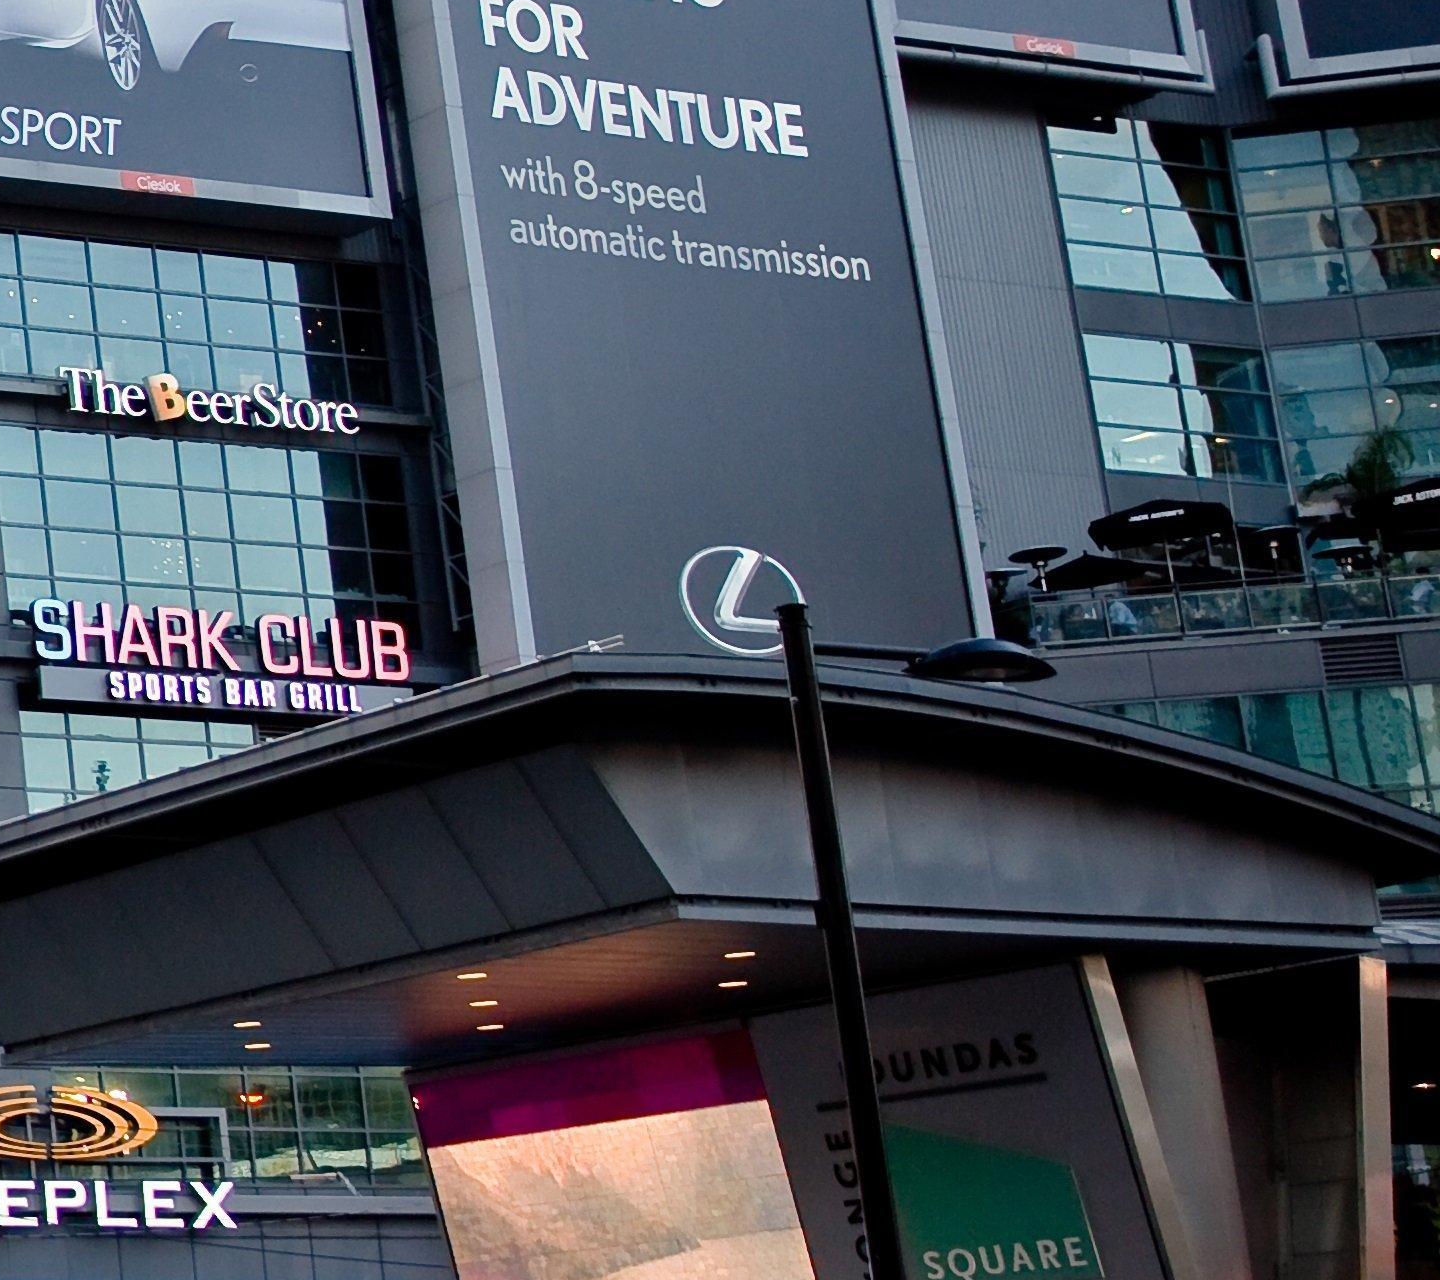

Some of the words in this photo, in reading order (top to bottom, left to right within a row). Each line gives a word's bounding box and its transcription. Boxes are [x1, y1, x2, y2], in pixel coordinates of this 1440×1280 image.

[1, 107, 122, 156] SPORT
[491, 66, 808, 157] ADVENTURE
[137, 176, 181, 193] Cieslok
[501, 156, 567, 197] with
[575, 159, 706, 214] 8-speed
[511, 215, 666, 262] automatic
[672, 230, 870, 281] transmission
[31, 598, 242, 672] SHARK
[258, 612, 411, 682] CLUB
[110, 670, 211, 707] SPORTS
[226, 677, 277, 710] BAR
[290, 682, 363, 714] GRILL
